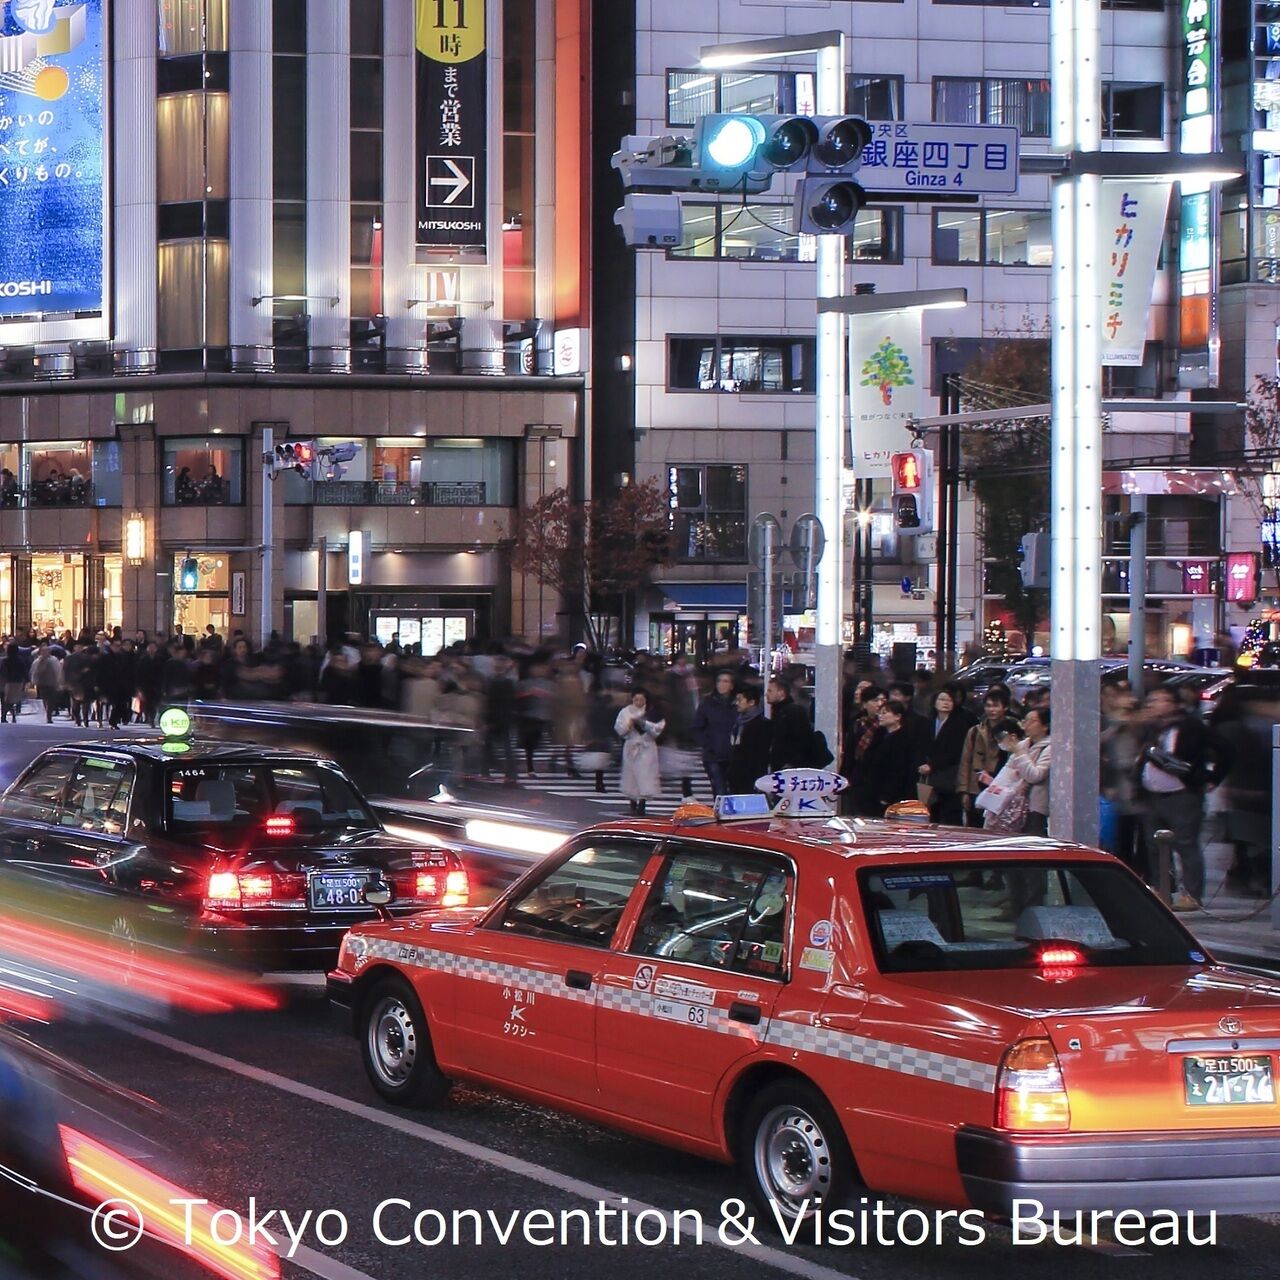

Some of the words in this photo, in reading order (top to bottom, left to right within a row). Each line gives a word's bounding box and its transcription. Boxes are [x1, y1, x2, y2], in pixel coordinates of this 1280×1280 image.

[439, 34, 462, 57] 時
[440, 65, 462, 146] まで営業
[861, 140, 1008, 170] 銀座四丁目
[905, 171, 947, 187] Ginza
[953, 172, 963, 186] 4
[418, 220, 481, 232] MITSUKOSHI
[1106, 192, 1138, 340] ヒカリミチ
[179, 769, 206, 777] 1464
[790, 776, 831, 792] チェッカー
[798, 798, 817, 810] K
[326, 888, 365, 905] 48-0
[502, 986, 536, 1006] 小松川
[510, 1004, 526, 1022] K
[687, 1006, 705, 1024] 63
[503, 1021, 537, 1038] タクシー
[1204, 1059, 1230, 1073] 足立
[1230, 1058, 1253, 1073] 500
